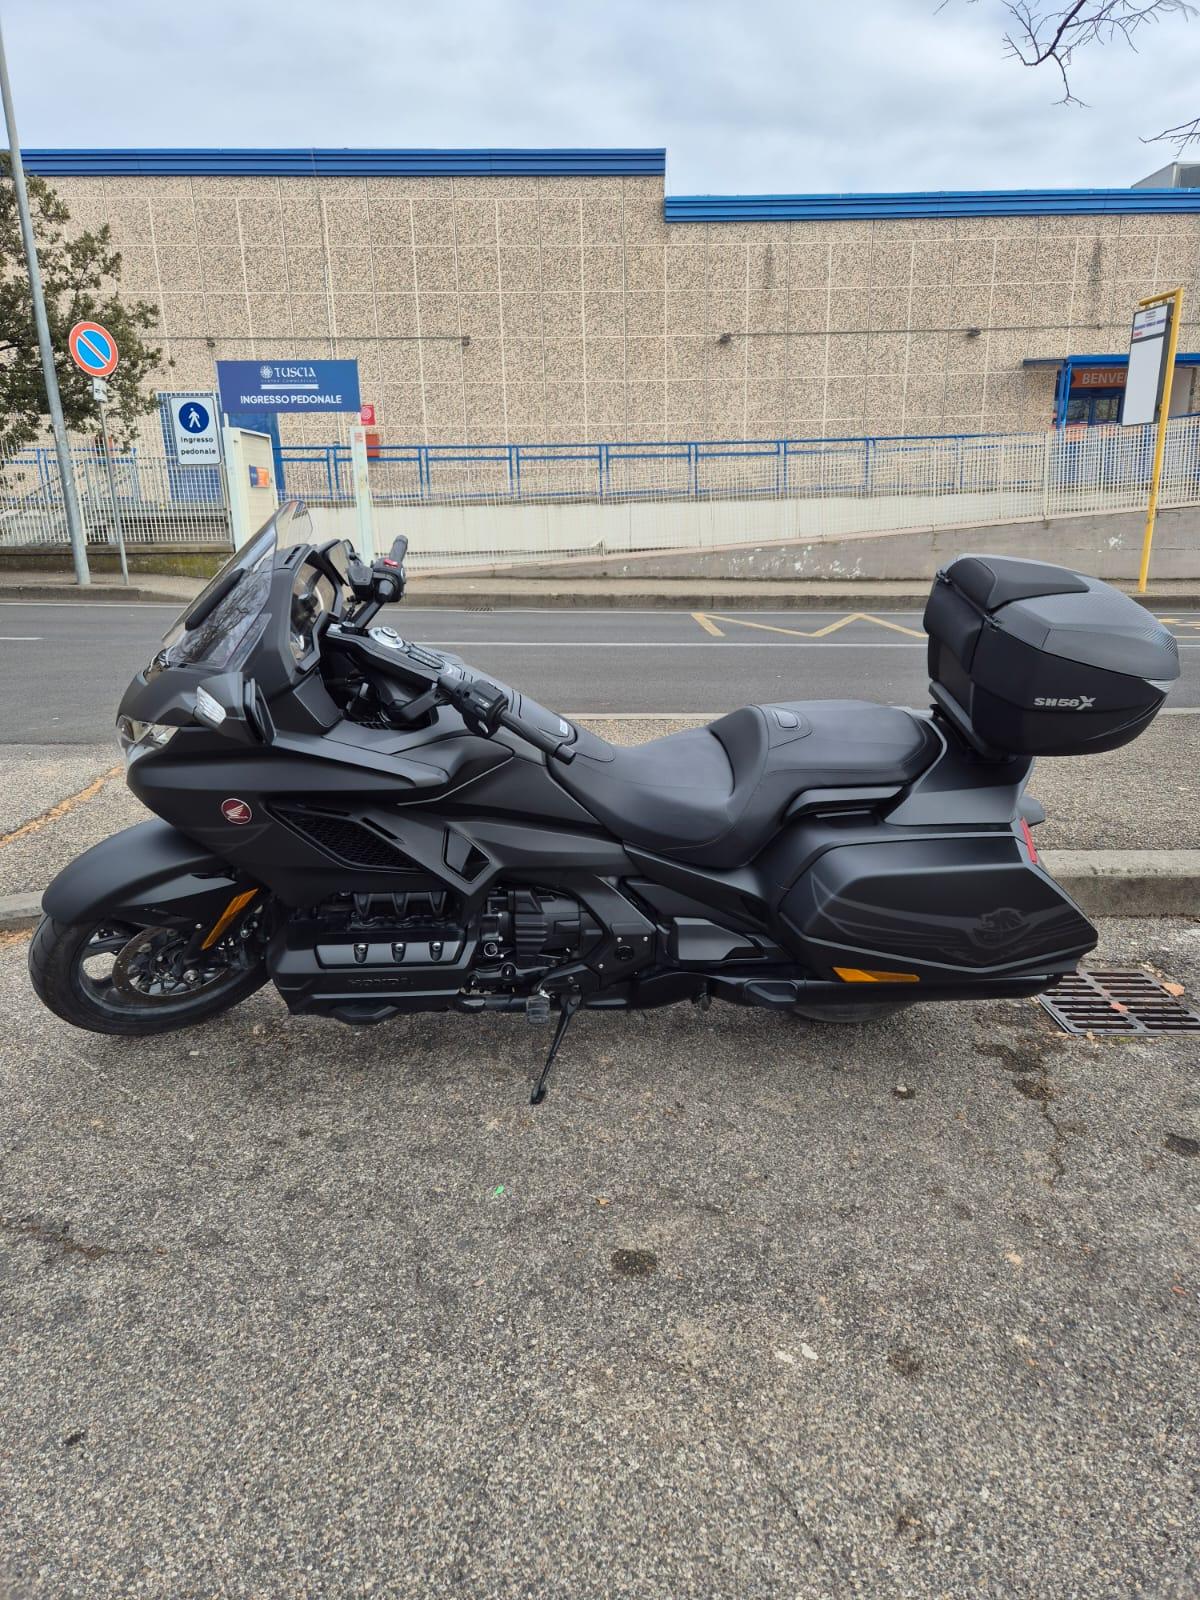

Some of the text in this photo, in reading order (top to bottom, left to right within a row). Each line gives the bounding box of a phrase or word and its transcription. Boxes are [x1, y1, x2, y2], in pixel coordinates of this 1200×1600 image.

[273, 367, 317, 378] TUSCIA
[240, 395, 342, 404] INGRESSO PEDONALE
[180, 447, 217, 456] pedonale
[1033, 695, 1097, 711] SH58X
